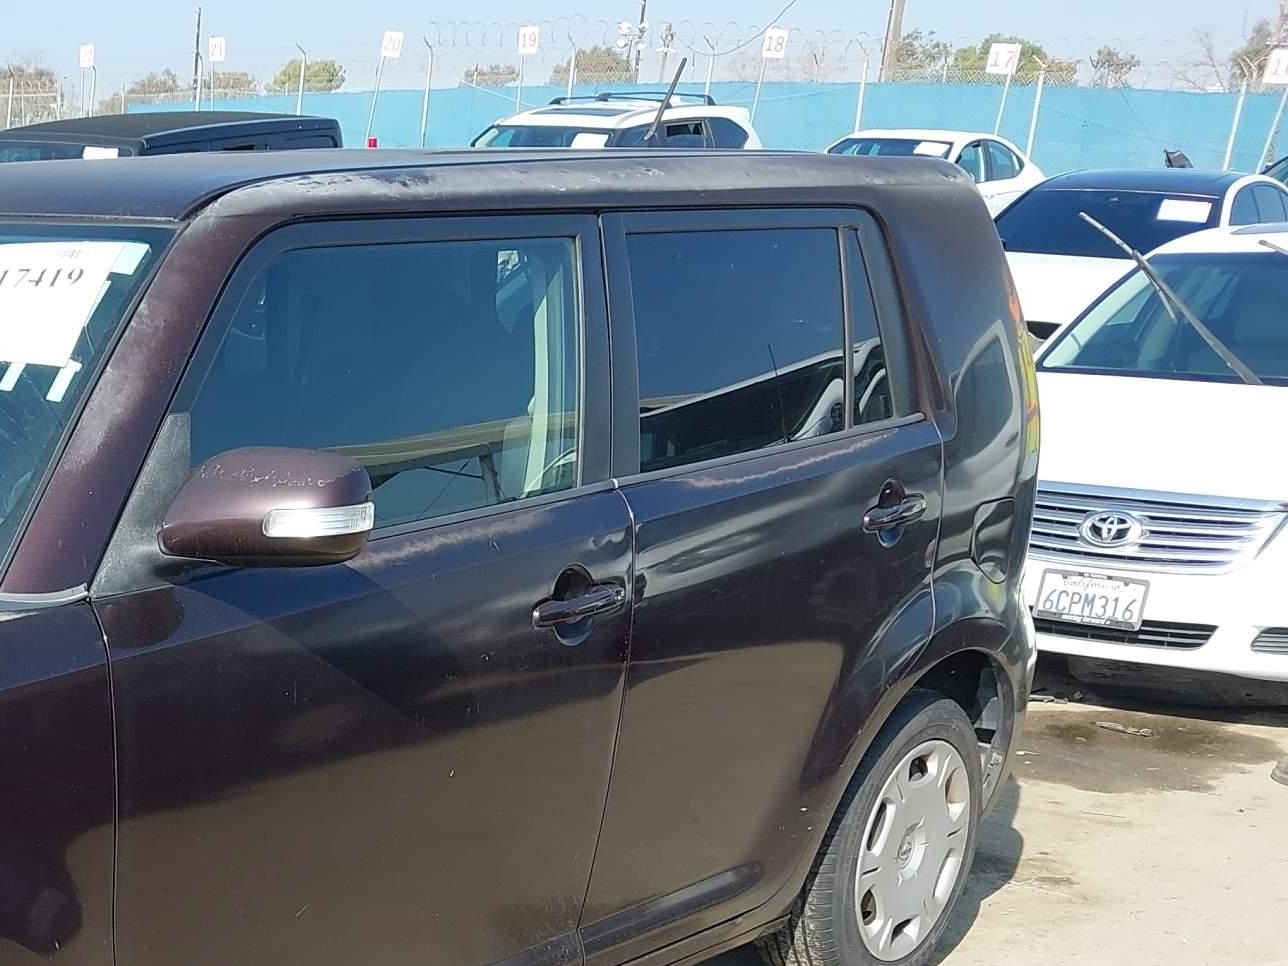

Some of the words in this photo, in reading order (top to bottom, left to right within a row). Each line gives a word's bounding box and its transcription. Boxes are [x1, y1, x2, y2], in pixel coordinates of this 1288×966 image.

[384, 36, 401, 51] 20
[522, 31, 537, 48] 19
[765, 36, 784, 52] 18
[989, 50, 1016, 68] 17
[1043, 588, 1137, 621] 6CPM316
